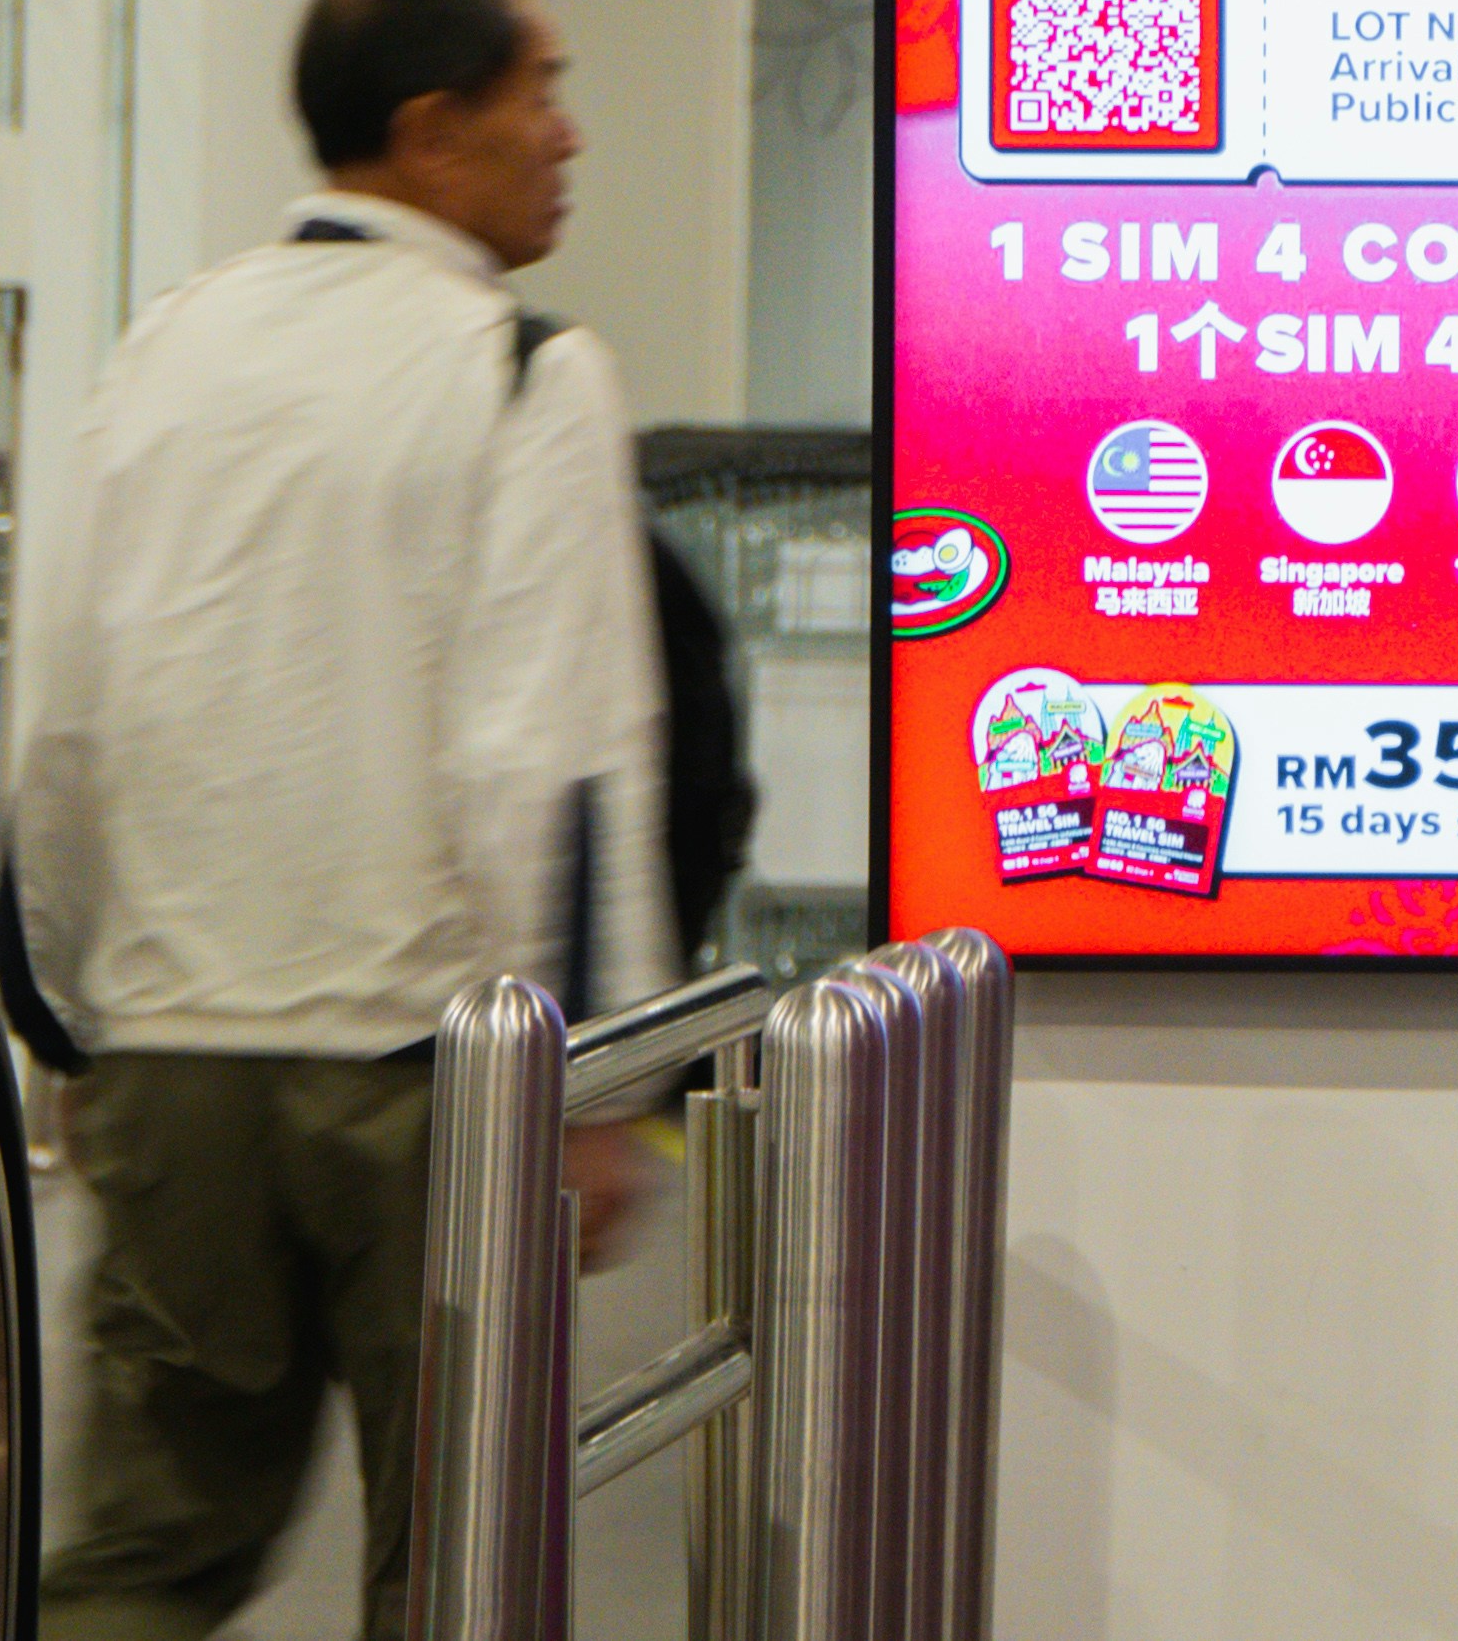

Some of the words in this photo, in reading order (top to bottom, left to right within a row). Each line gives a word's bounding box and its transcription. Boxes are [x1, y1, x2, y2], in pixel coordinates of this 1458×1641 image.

[1331, 10, 1411, 43] LOT
[1330, 91, 1456, 124] Public
[989, 220, 1025, 282] 1
[1059, 219, 1220, 283] SIM
[1254, 220, 1308, 283] 4
[1083, 554, 1211, 589] Malaysia
[1259, 554, 1406, 590] Singapore
[1094, 586, 1200, 617] 马来西亚
[1292, 586, 1372, 617] 新加坡
[1276, 803, 1326, 836] 15
[1339, 803, 1442, 846] days
